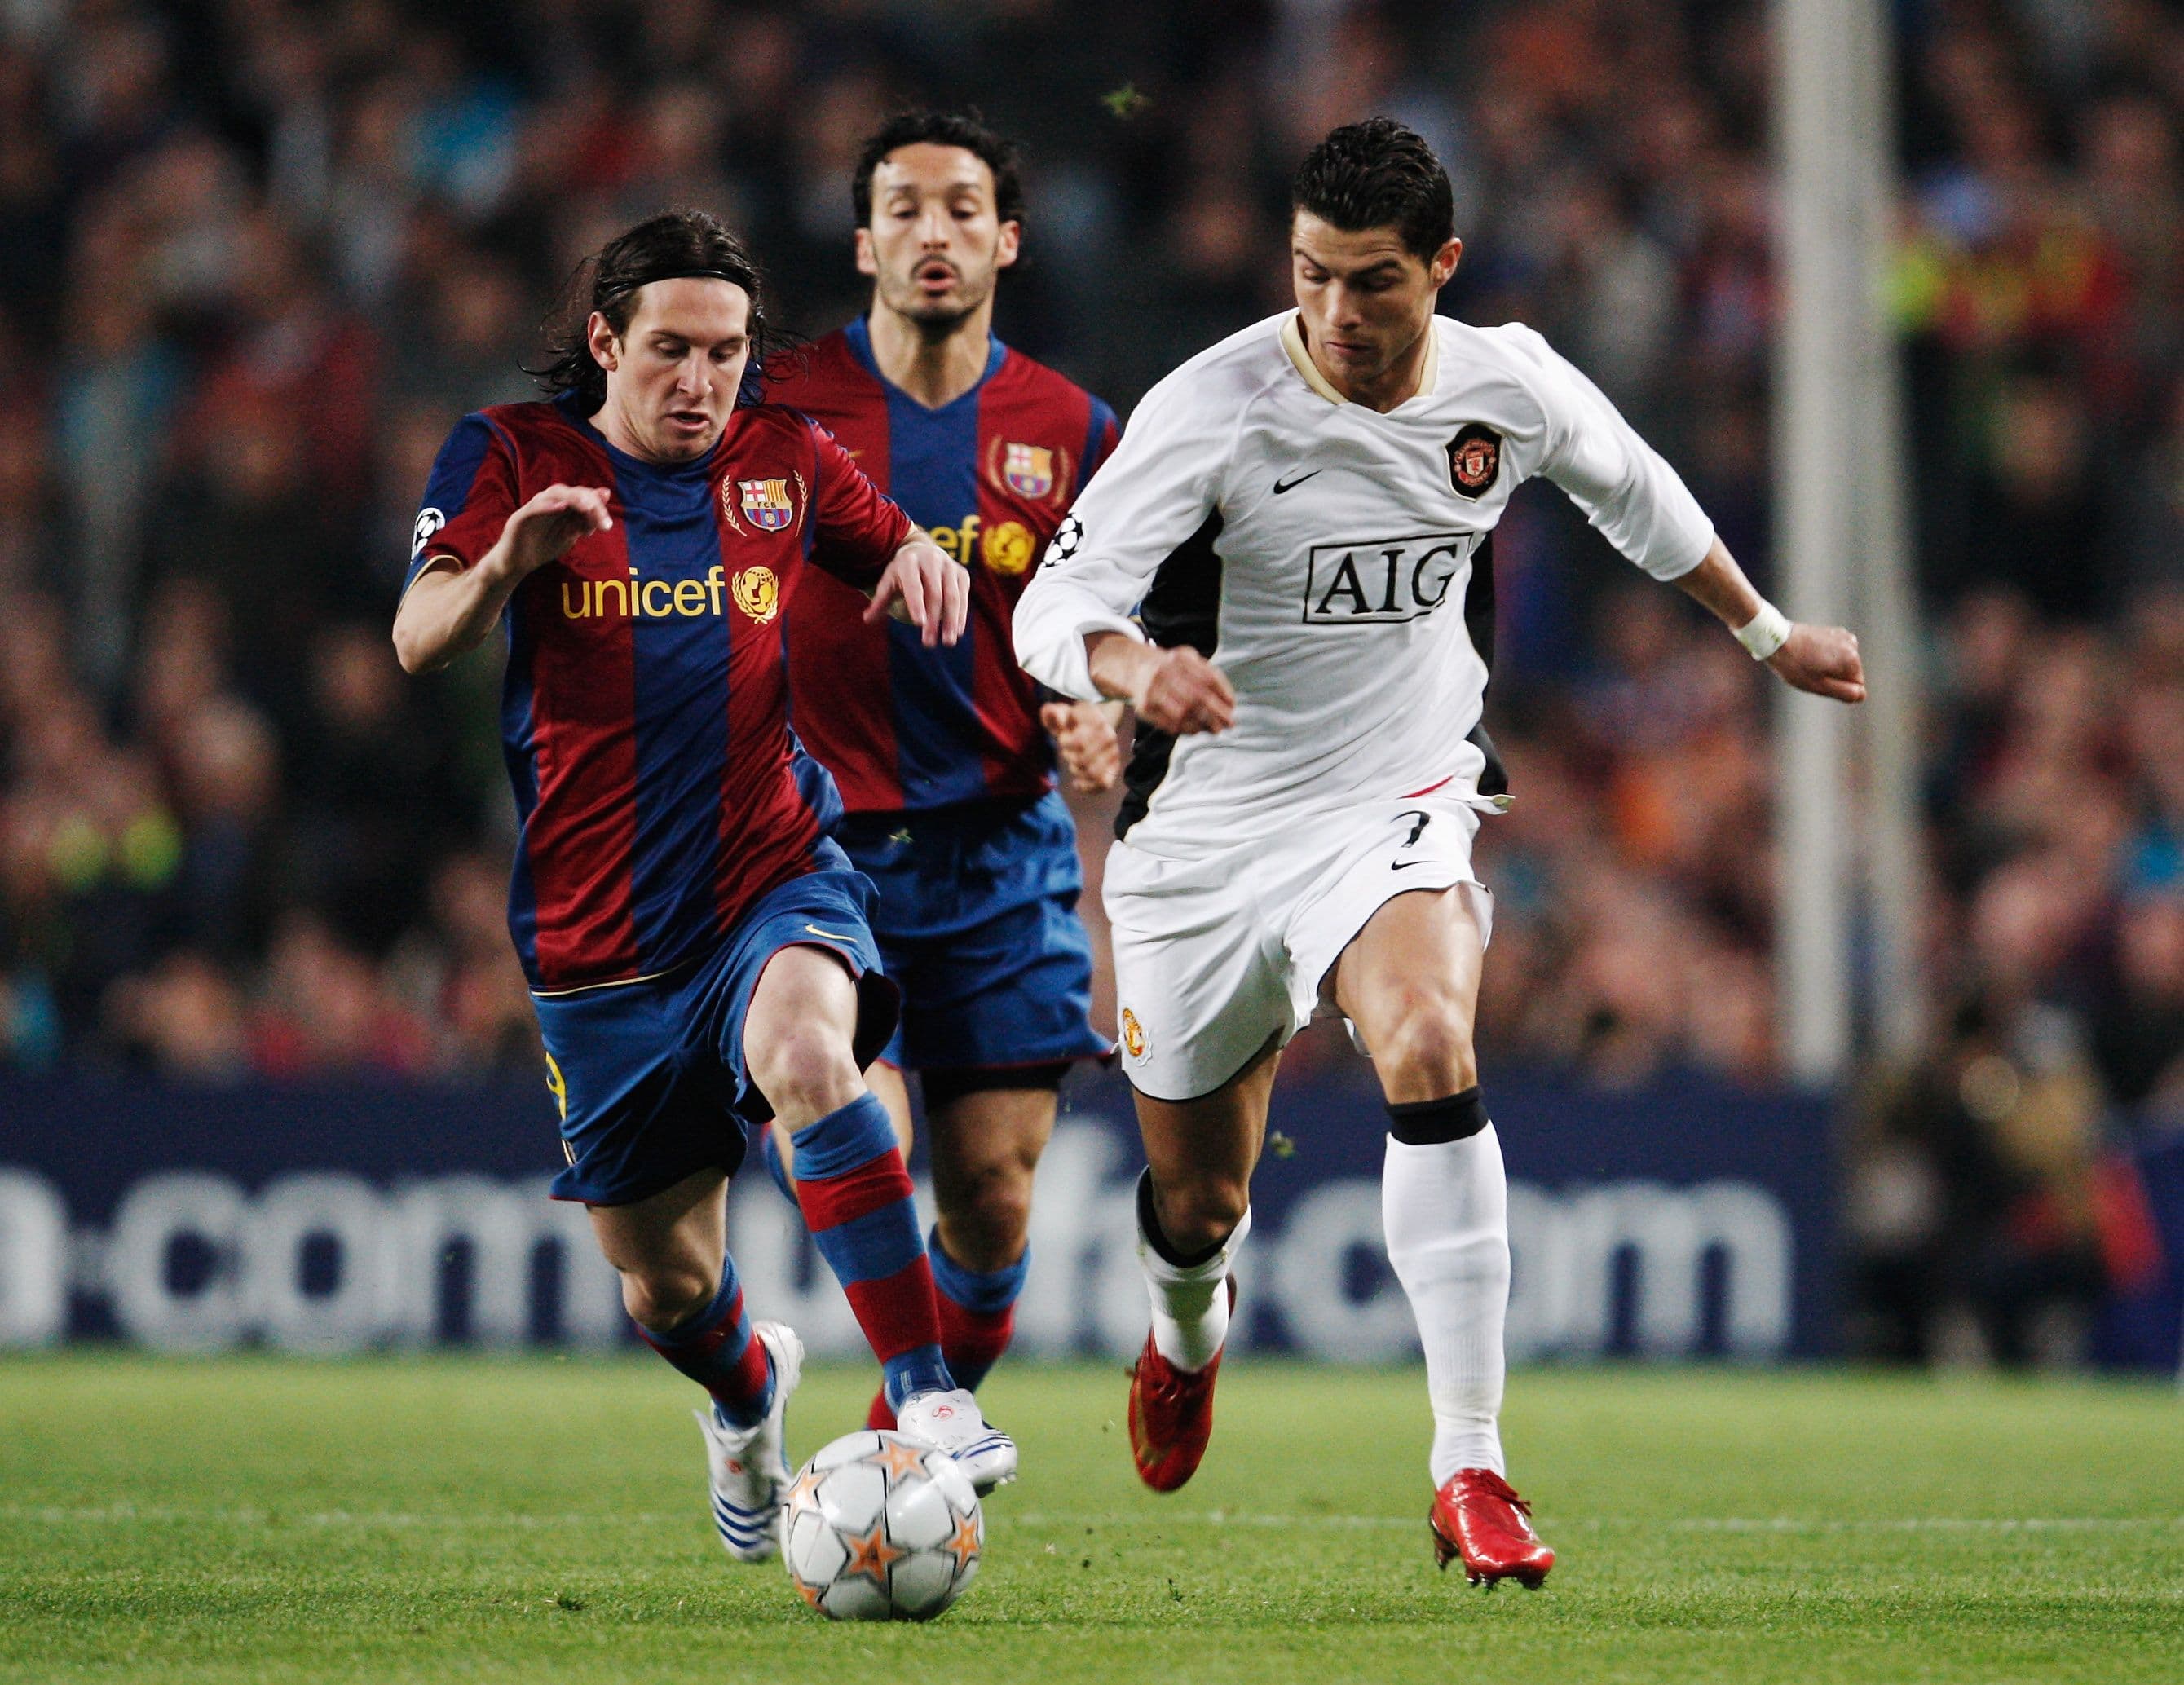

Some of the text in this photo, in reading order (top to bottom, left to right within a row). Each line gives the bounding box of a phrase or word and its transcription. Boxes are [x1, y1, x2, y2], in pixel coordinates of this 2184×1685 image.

[562, 566, 726, 620] unicef
[1315, 544, 1458, 614] AIG
[1389, 809, 1432, 849] 7
